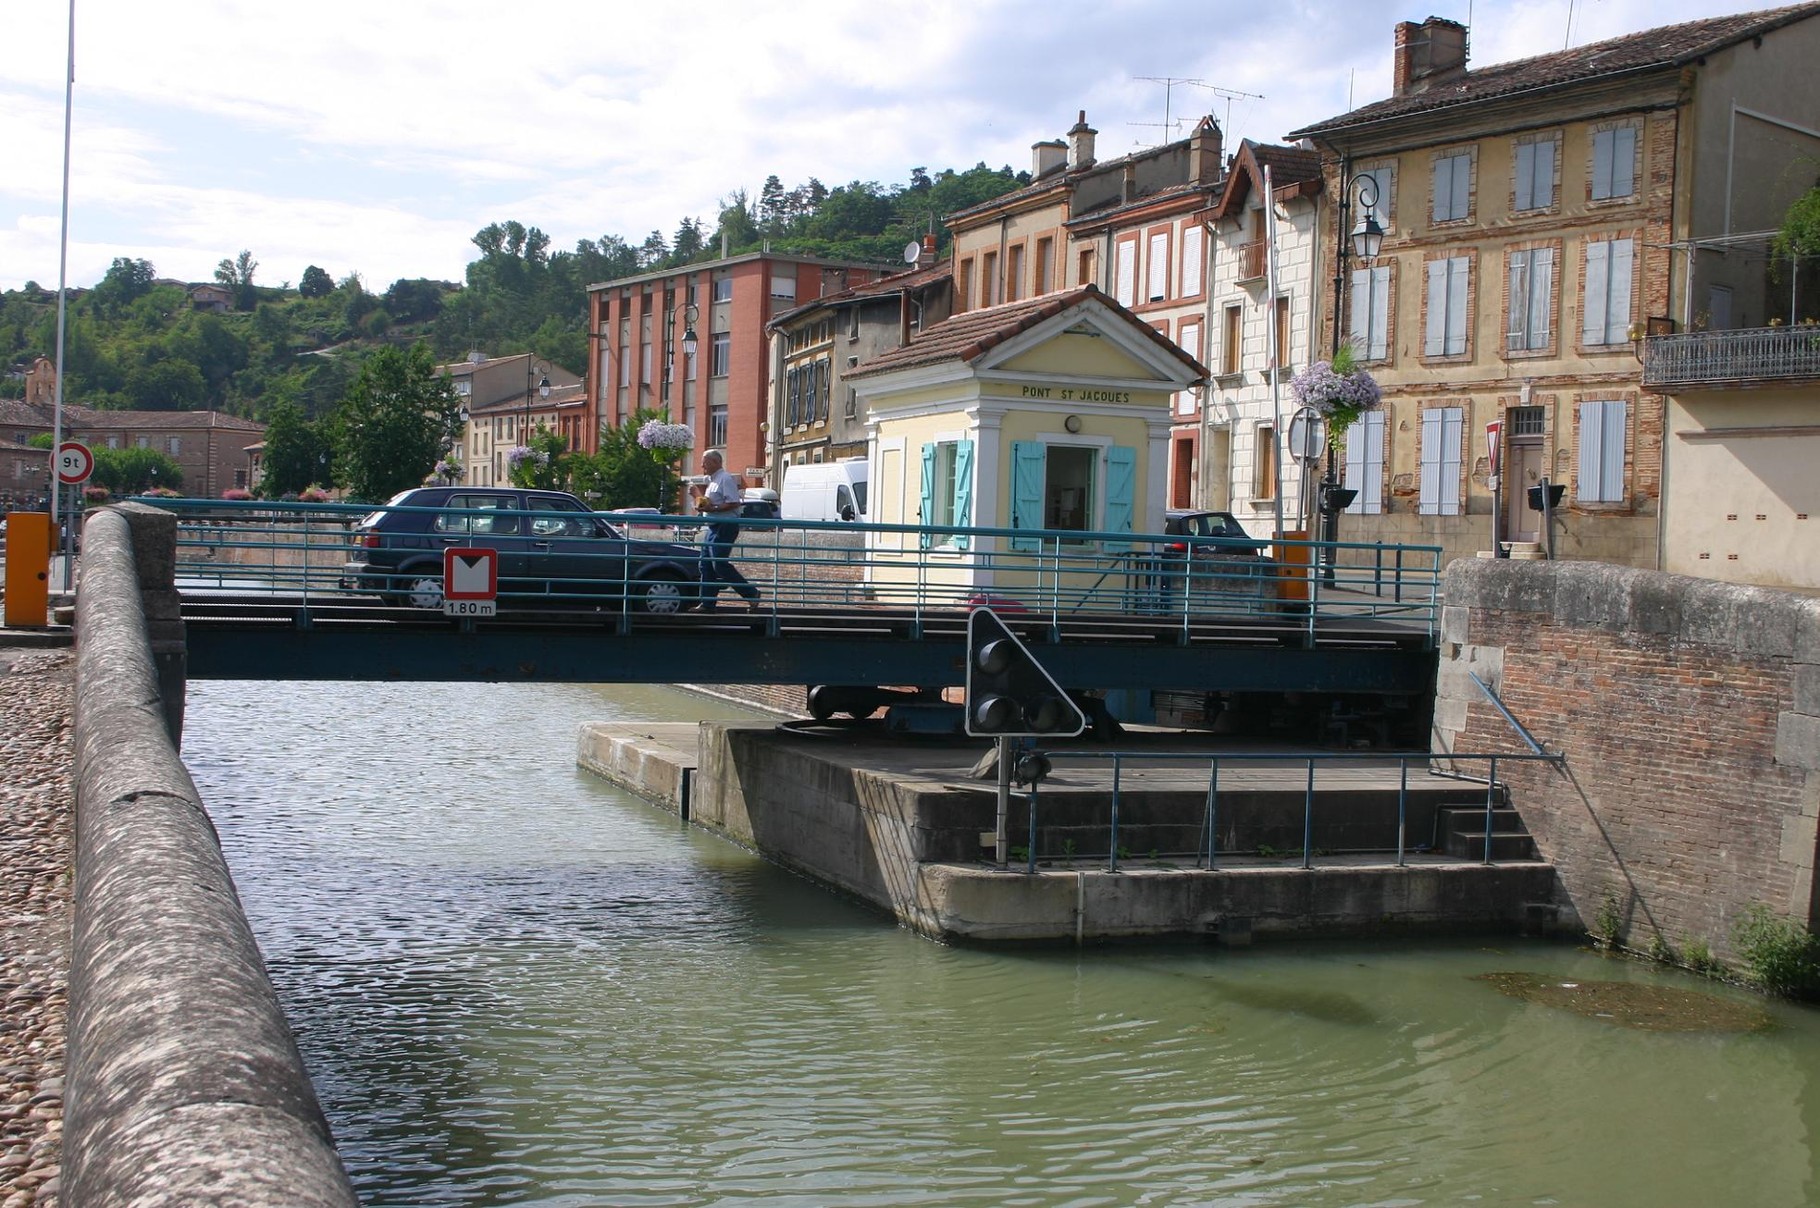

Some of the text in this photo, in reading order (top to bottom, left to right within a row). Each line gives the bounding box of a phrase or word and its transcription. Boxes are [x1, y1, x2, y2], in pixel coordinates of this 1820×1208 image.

[1022, 385, 1051, 398] PONT
[1061, 389, 1073, 400] ST
[448, 603, 492, 614] 1.80 m
